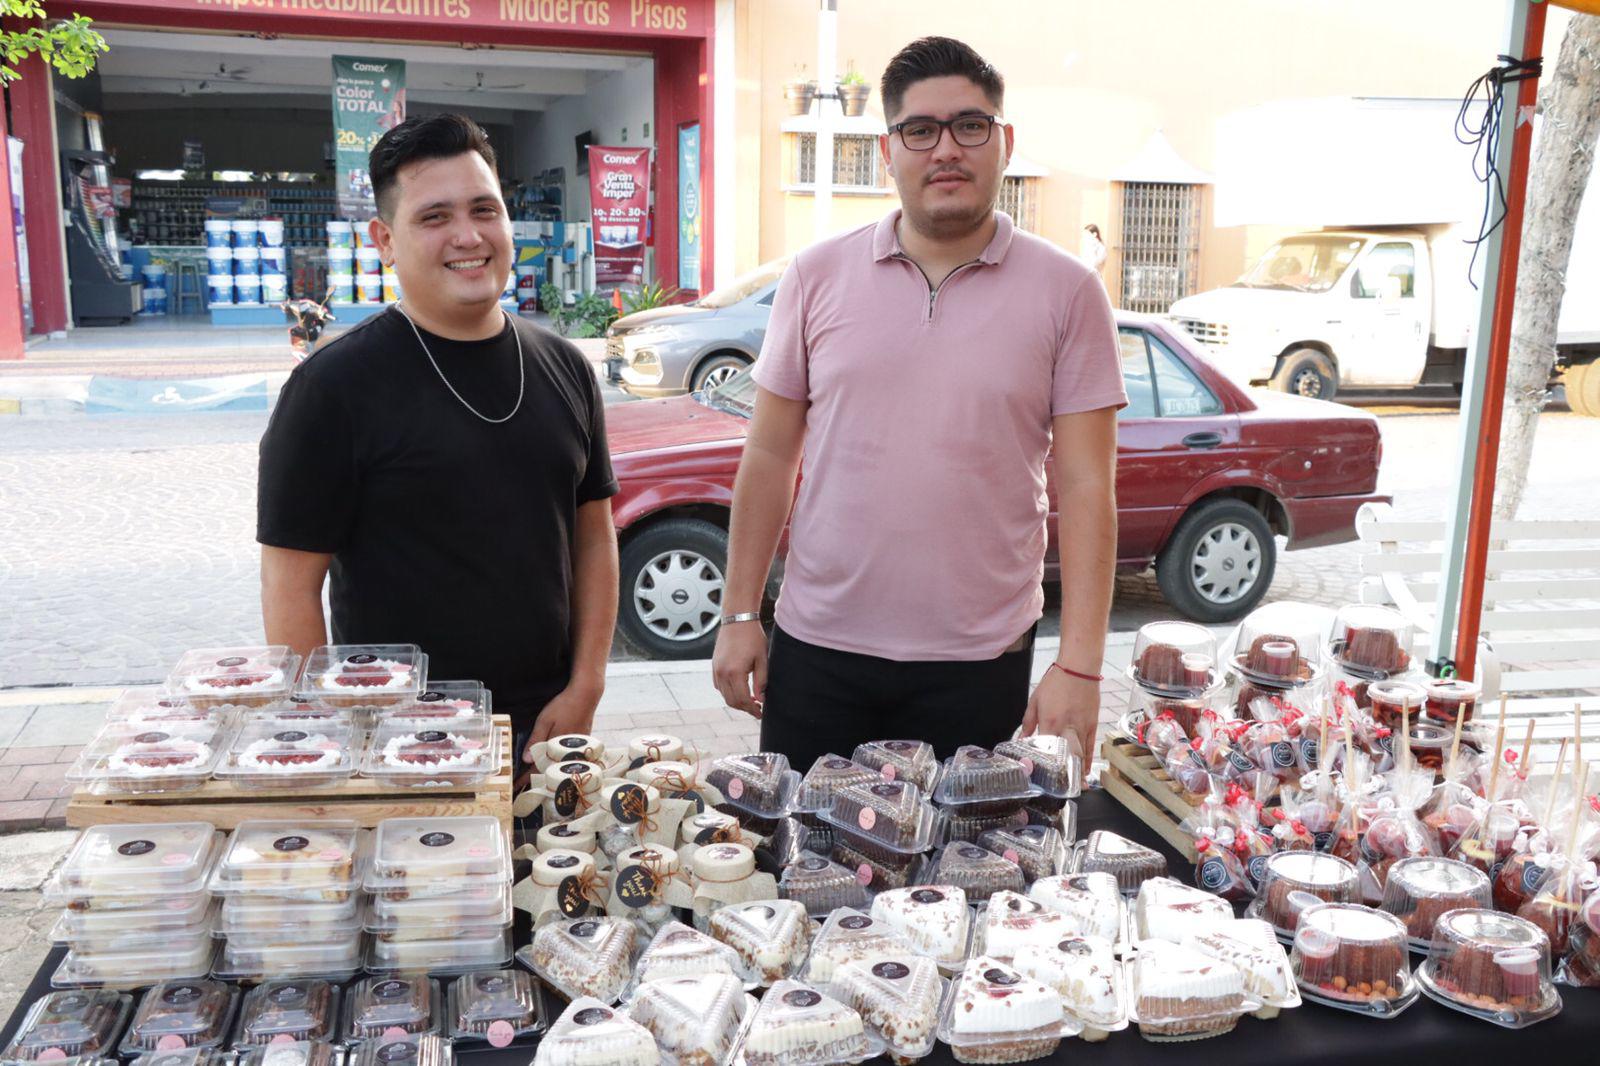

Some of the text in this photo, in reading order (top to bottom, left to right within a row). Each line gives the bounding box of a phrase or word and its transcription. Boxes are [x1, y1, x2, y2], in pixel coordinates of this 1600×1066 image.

[500, 0, 610, 25] Maderas
[630, 0, 687, 30] Pisos
[353, 62, 388, 73] Comex
[336, 85, 375, 99] Color
[337, 98, 387, 113] TOTAL
[603, 154, 640, 165] Comex
[607, 172, 633, 182] Gran
[603, 180, 635, 190] Venta
[603, 188, 634, 200] Imper
